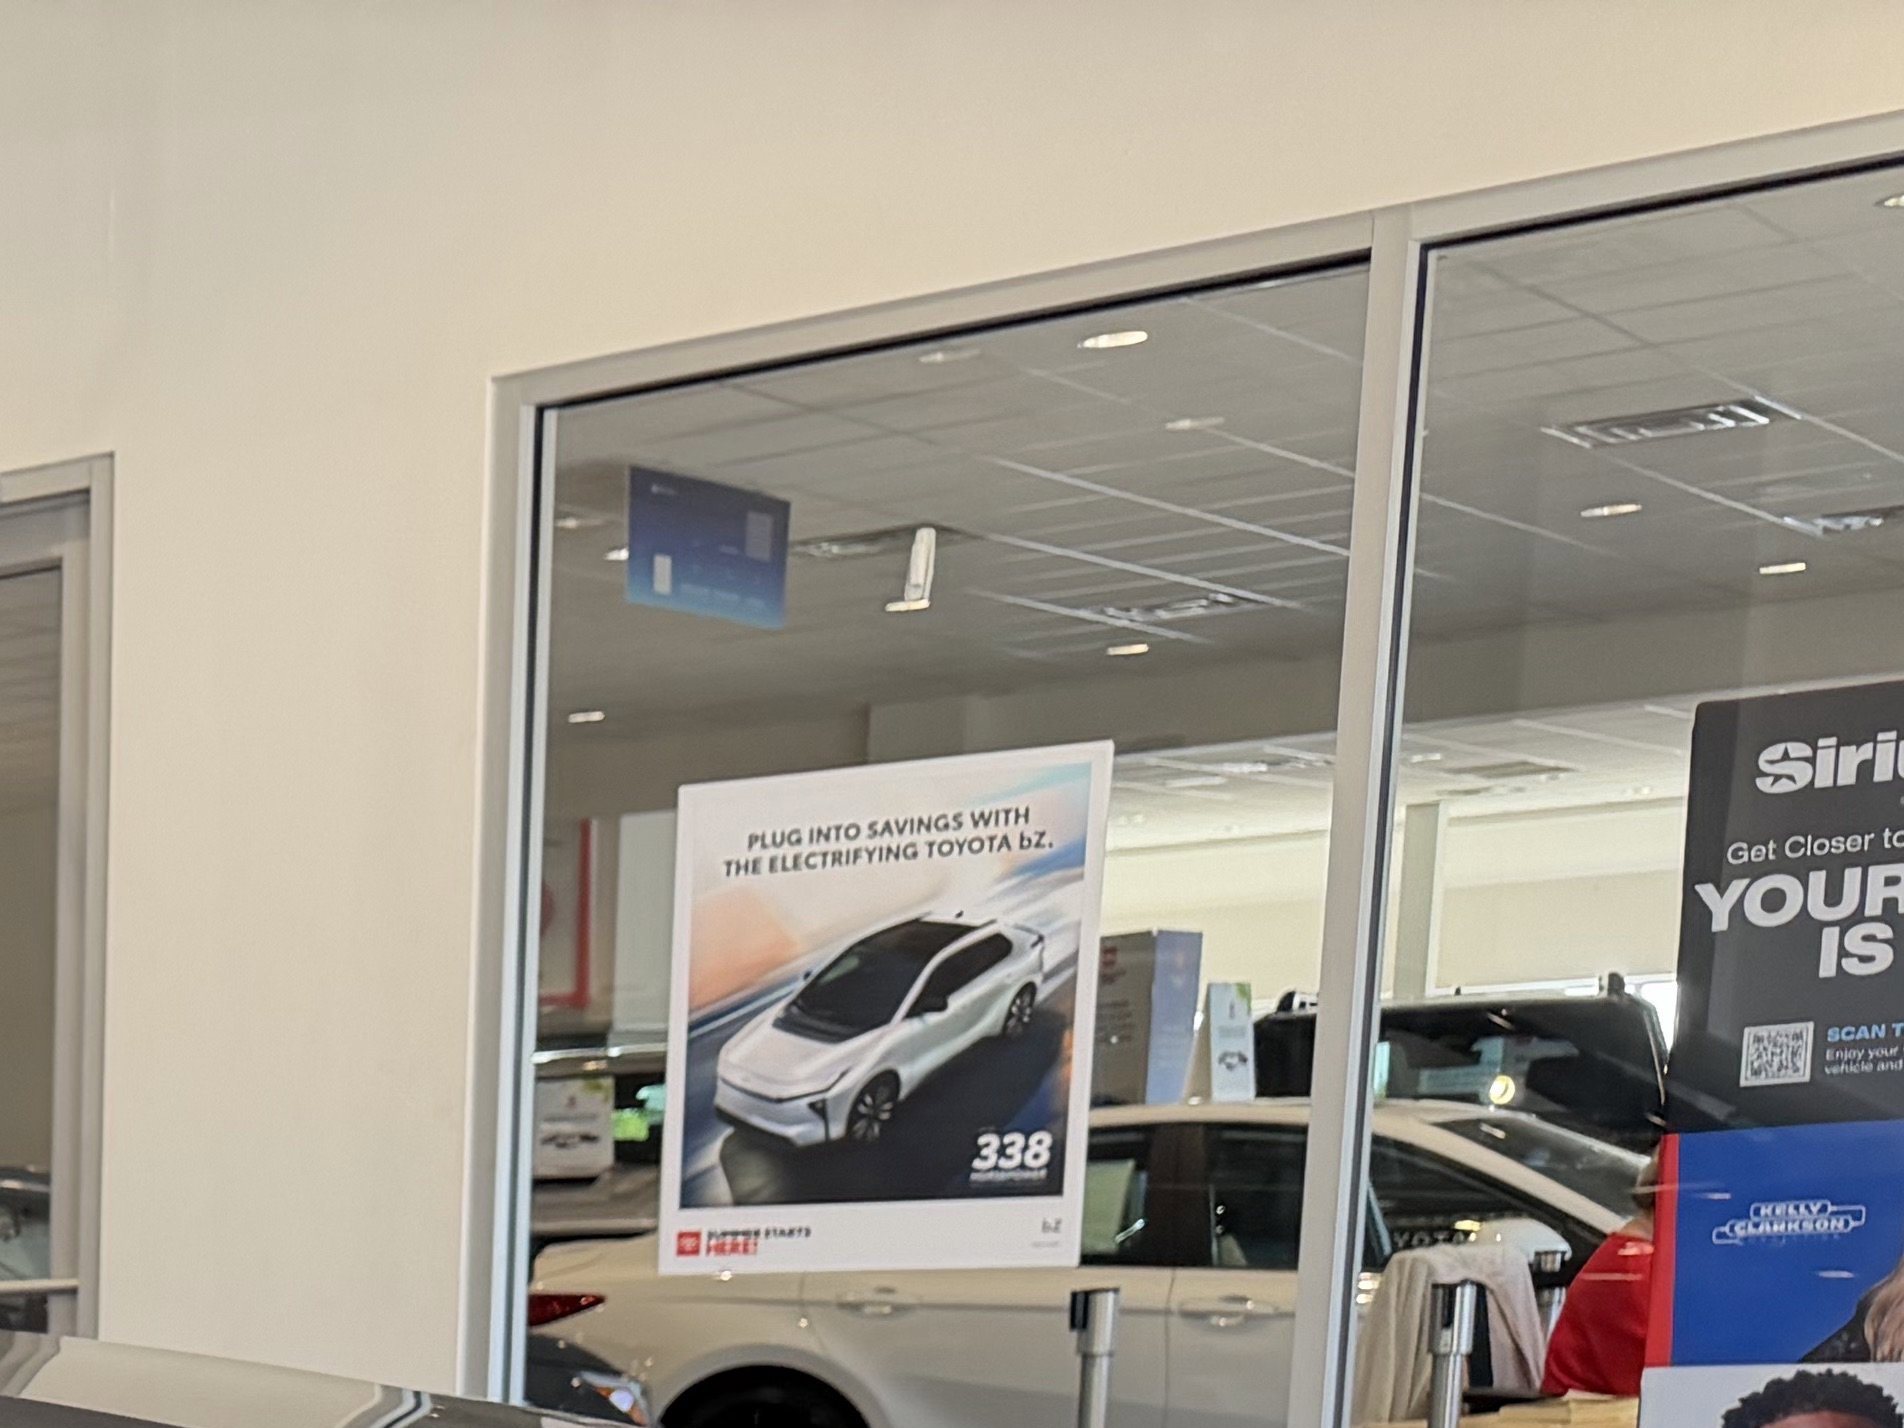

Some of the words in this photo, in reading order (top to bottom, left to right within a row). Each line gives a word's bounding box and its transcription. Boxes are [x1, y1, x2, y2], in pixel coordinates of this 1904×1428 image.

[747, 828, 804, 851] PLUG
[808, 822, 862, 845] INTO
[867, 811, 964, 840] SAVINGS
[970, 805, 1031, 829] WITH
[1726, 839, 1777, 865] Get
[1784, 832, 1875, 859] Closer
[724, 852, 762, 878] THE
[768, 841, 919, 874] ELECTRIFYING
[925, 833, 1012, 860] TOYOTA
[1818, 922, 1894, 979] IS
[1827, 1023, 1887, 1042] SCAN
[971, 1130, 1053, 1171] 338
[1759, 1201, 1823, 1218] KELLY
